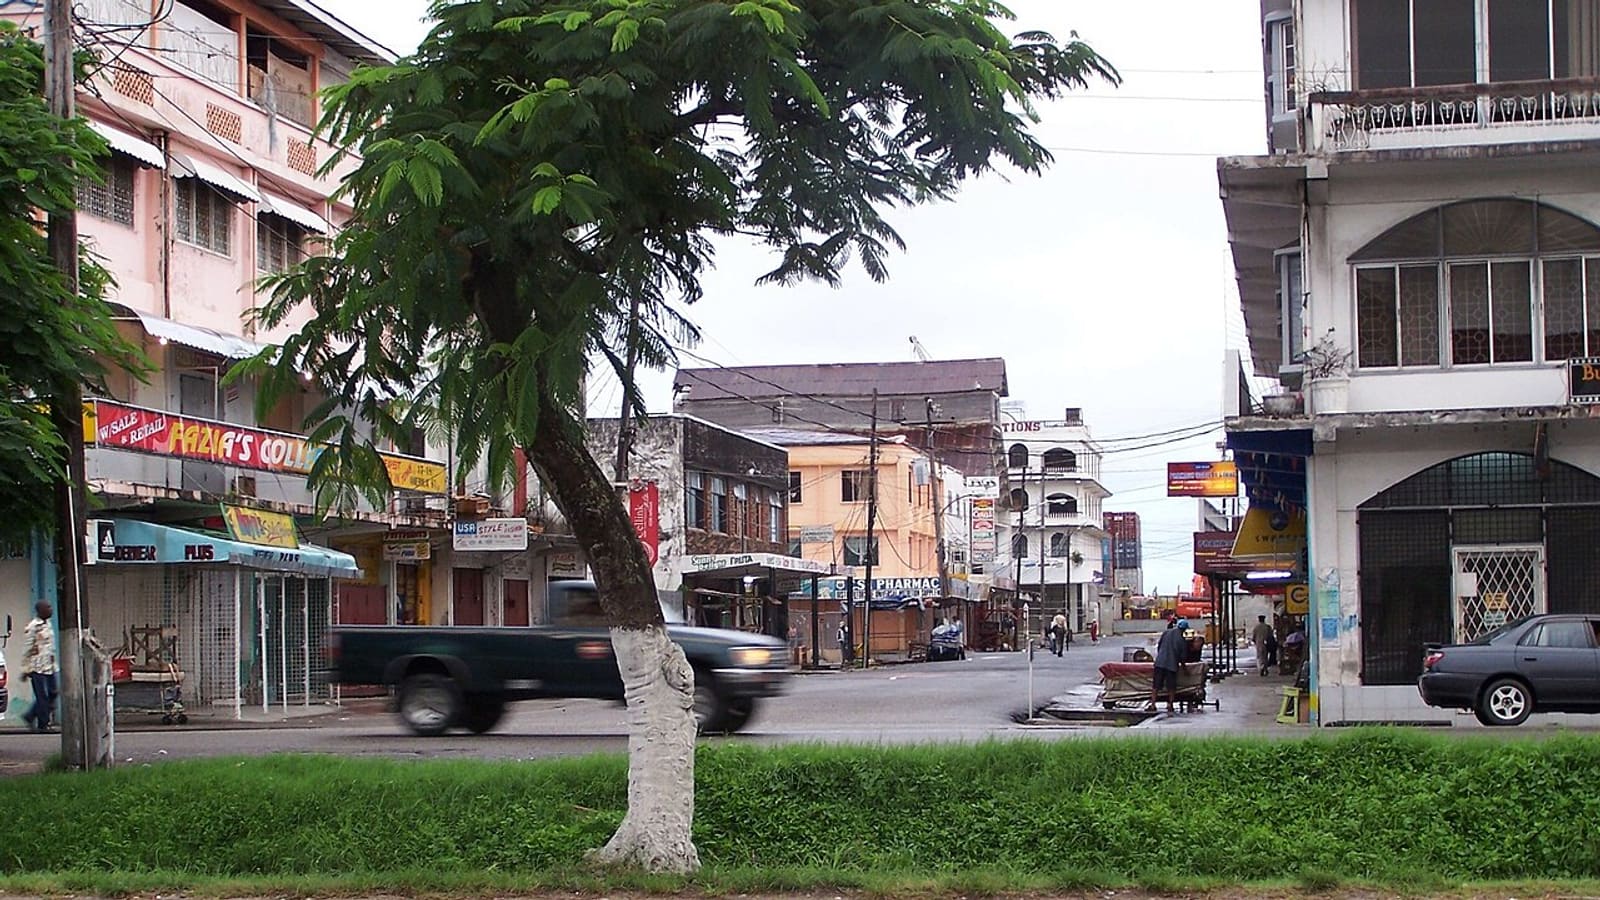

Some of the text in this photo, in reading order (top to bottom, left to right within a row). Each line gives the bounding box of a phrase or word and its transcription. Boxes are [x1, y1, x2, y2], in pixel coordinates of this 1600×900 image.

[99, 412, 138, 440] W/SALE
[129, 417, 165, 444] RETAIL
[1001, 421, 1041, 432] TIONS
[457, 523, 475, 532] USA
[478, 523, 503, 534] STYLE
[184, 545, 214, 560] PLUS
